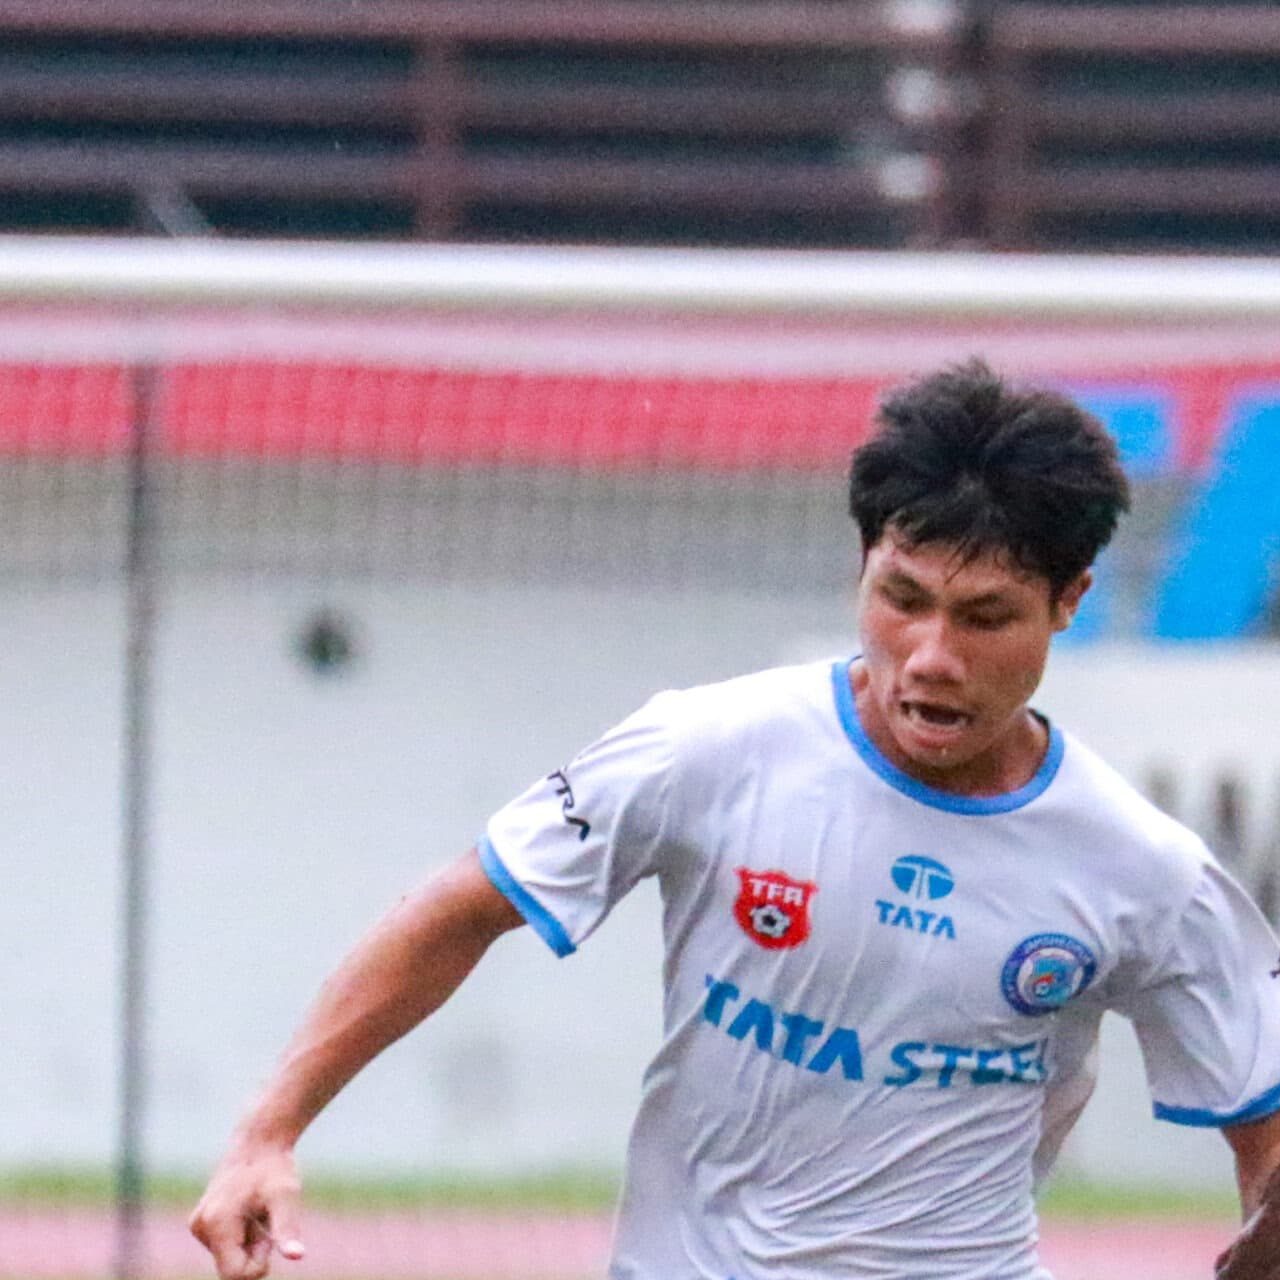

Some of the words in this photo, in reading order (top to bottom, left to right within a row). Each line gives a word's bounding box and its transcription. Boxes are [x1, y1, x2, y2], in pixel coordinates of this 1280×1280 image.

[749, 878, 804, 906] TFA
[874, 899, 956, 940] TATA
[704, 973, 864, 1082] TATA
